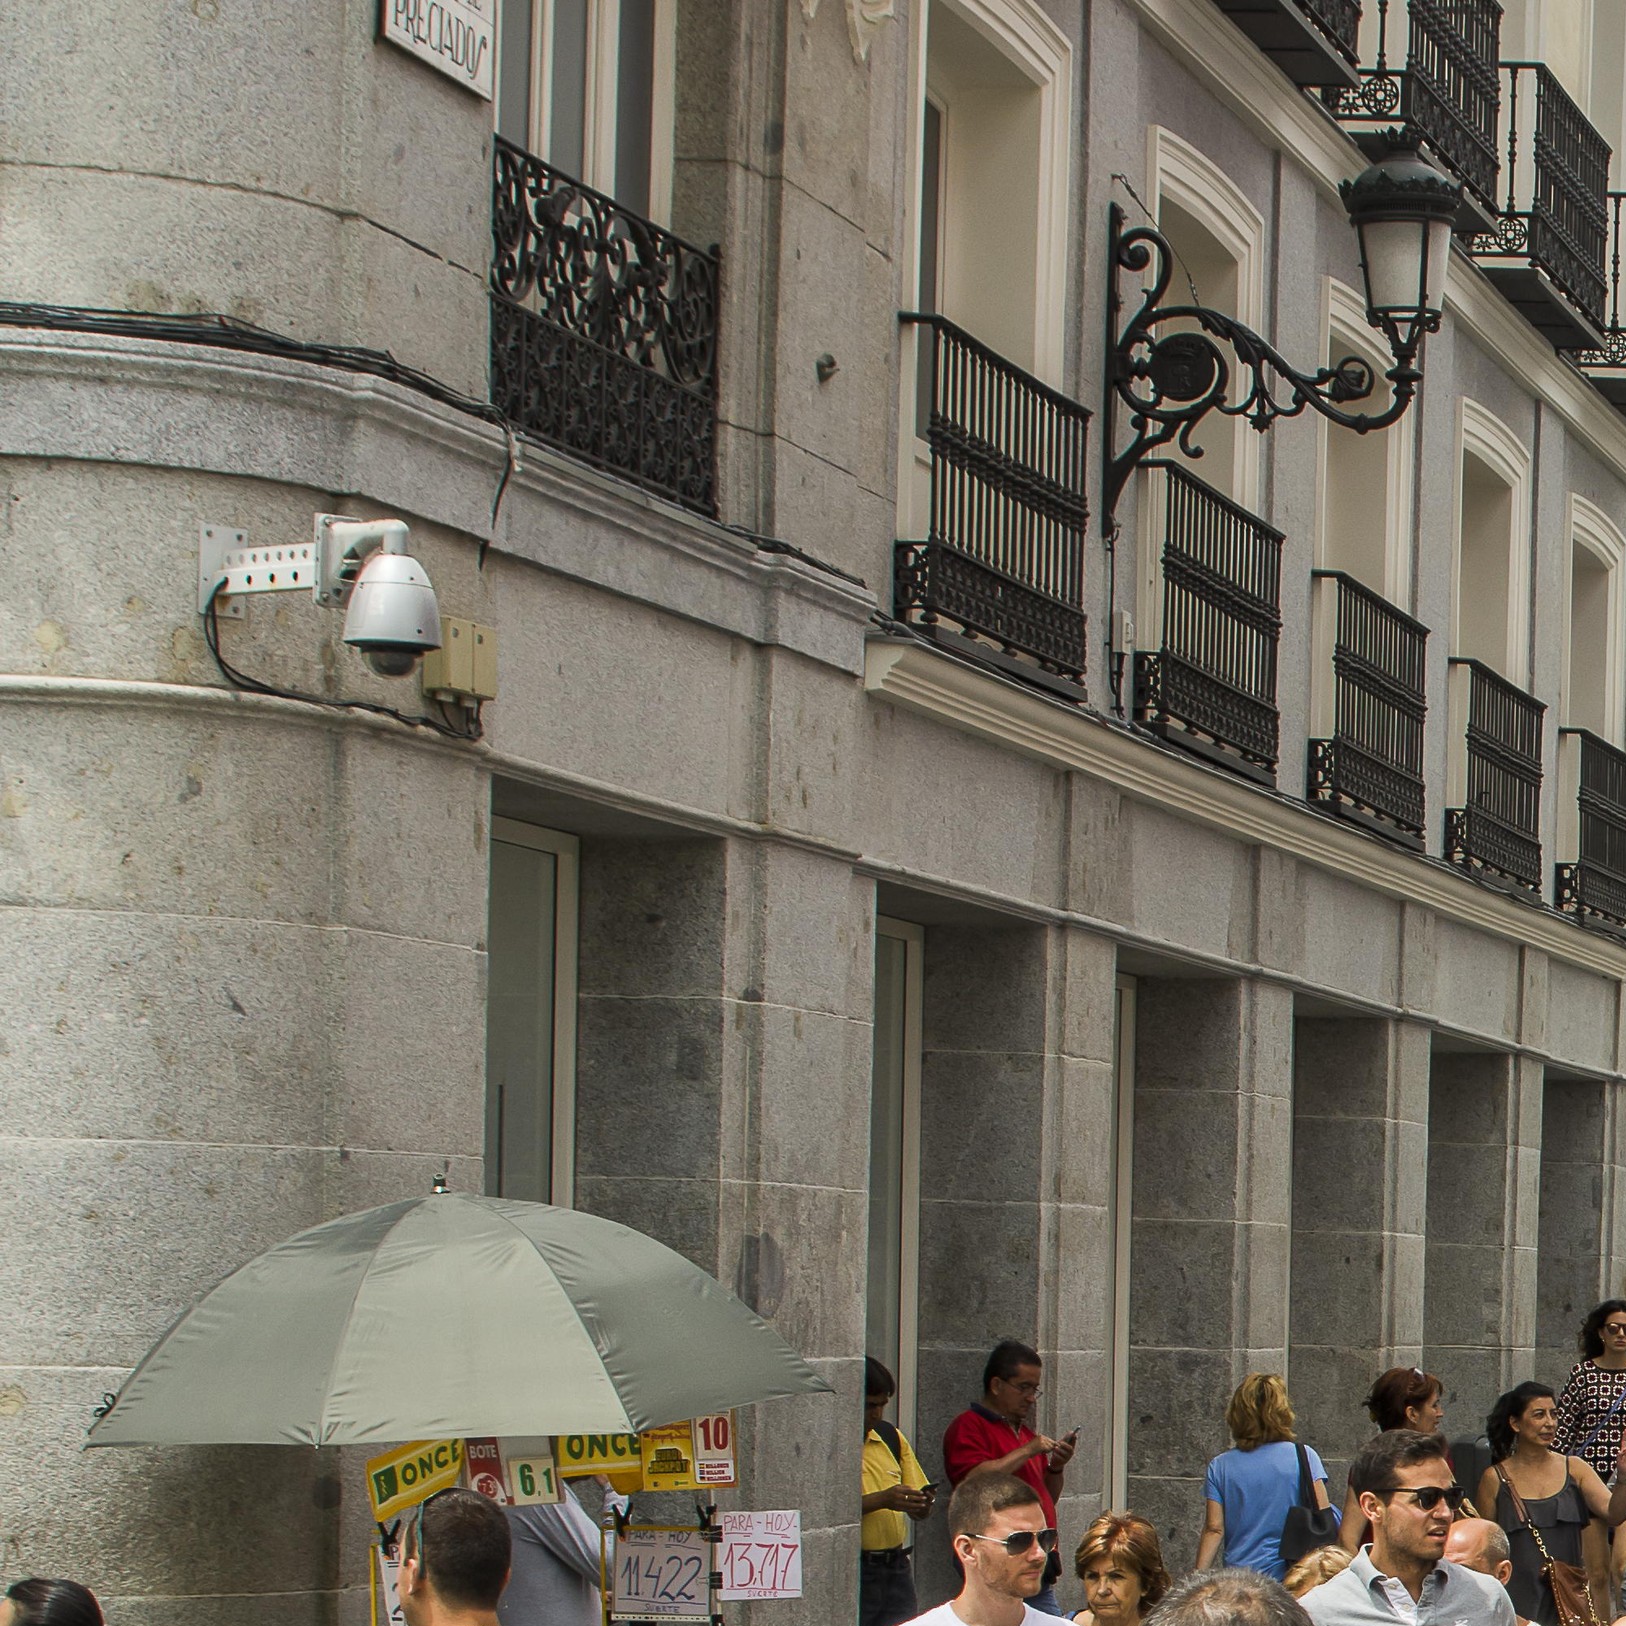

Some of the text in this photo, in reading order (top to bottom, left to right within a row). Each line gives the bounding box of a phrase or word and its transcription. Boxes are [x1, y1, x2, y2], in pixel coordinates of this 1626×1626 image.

[699, 1416, 729, 1451] 10
[469, 1443, 498, 1461] BOTE
[567, 1434, 641, 1461] ONCE
[400, 1438, 460, 1489] ONCE
[723, 1514, 753, 1533] PARA
